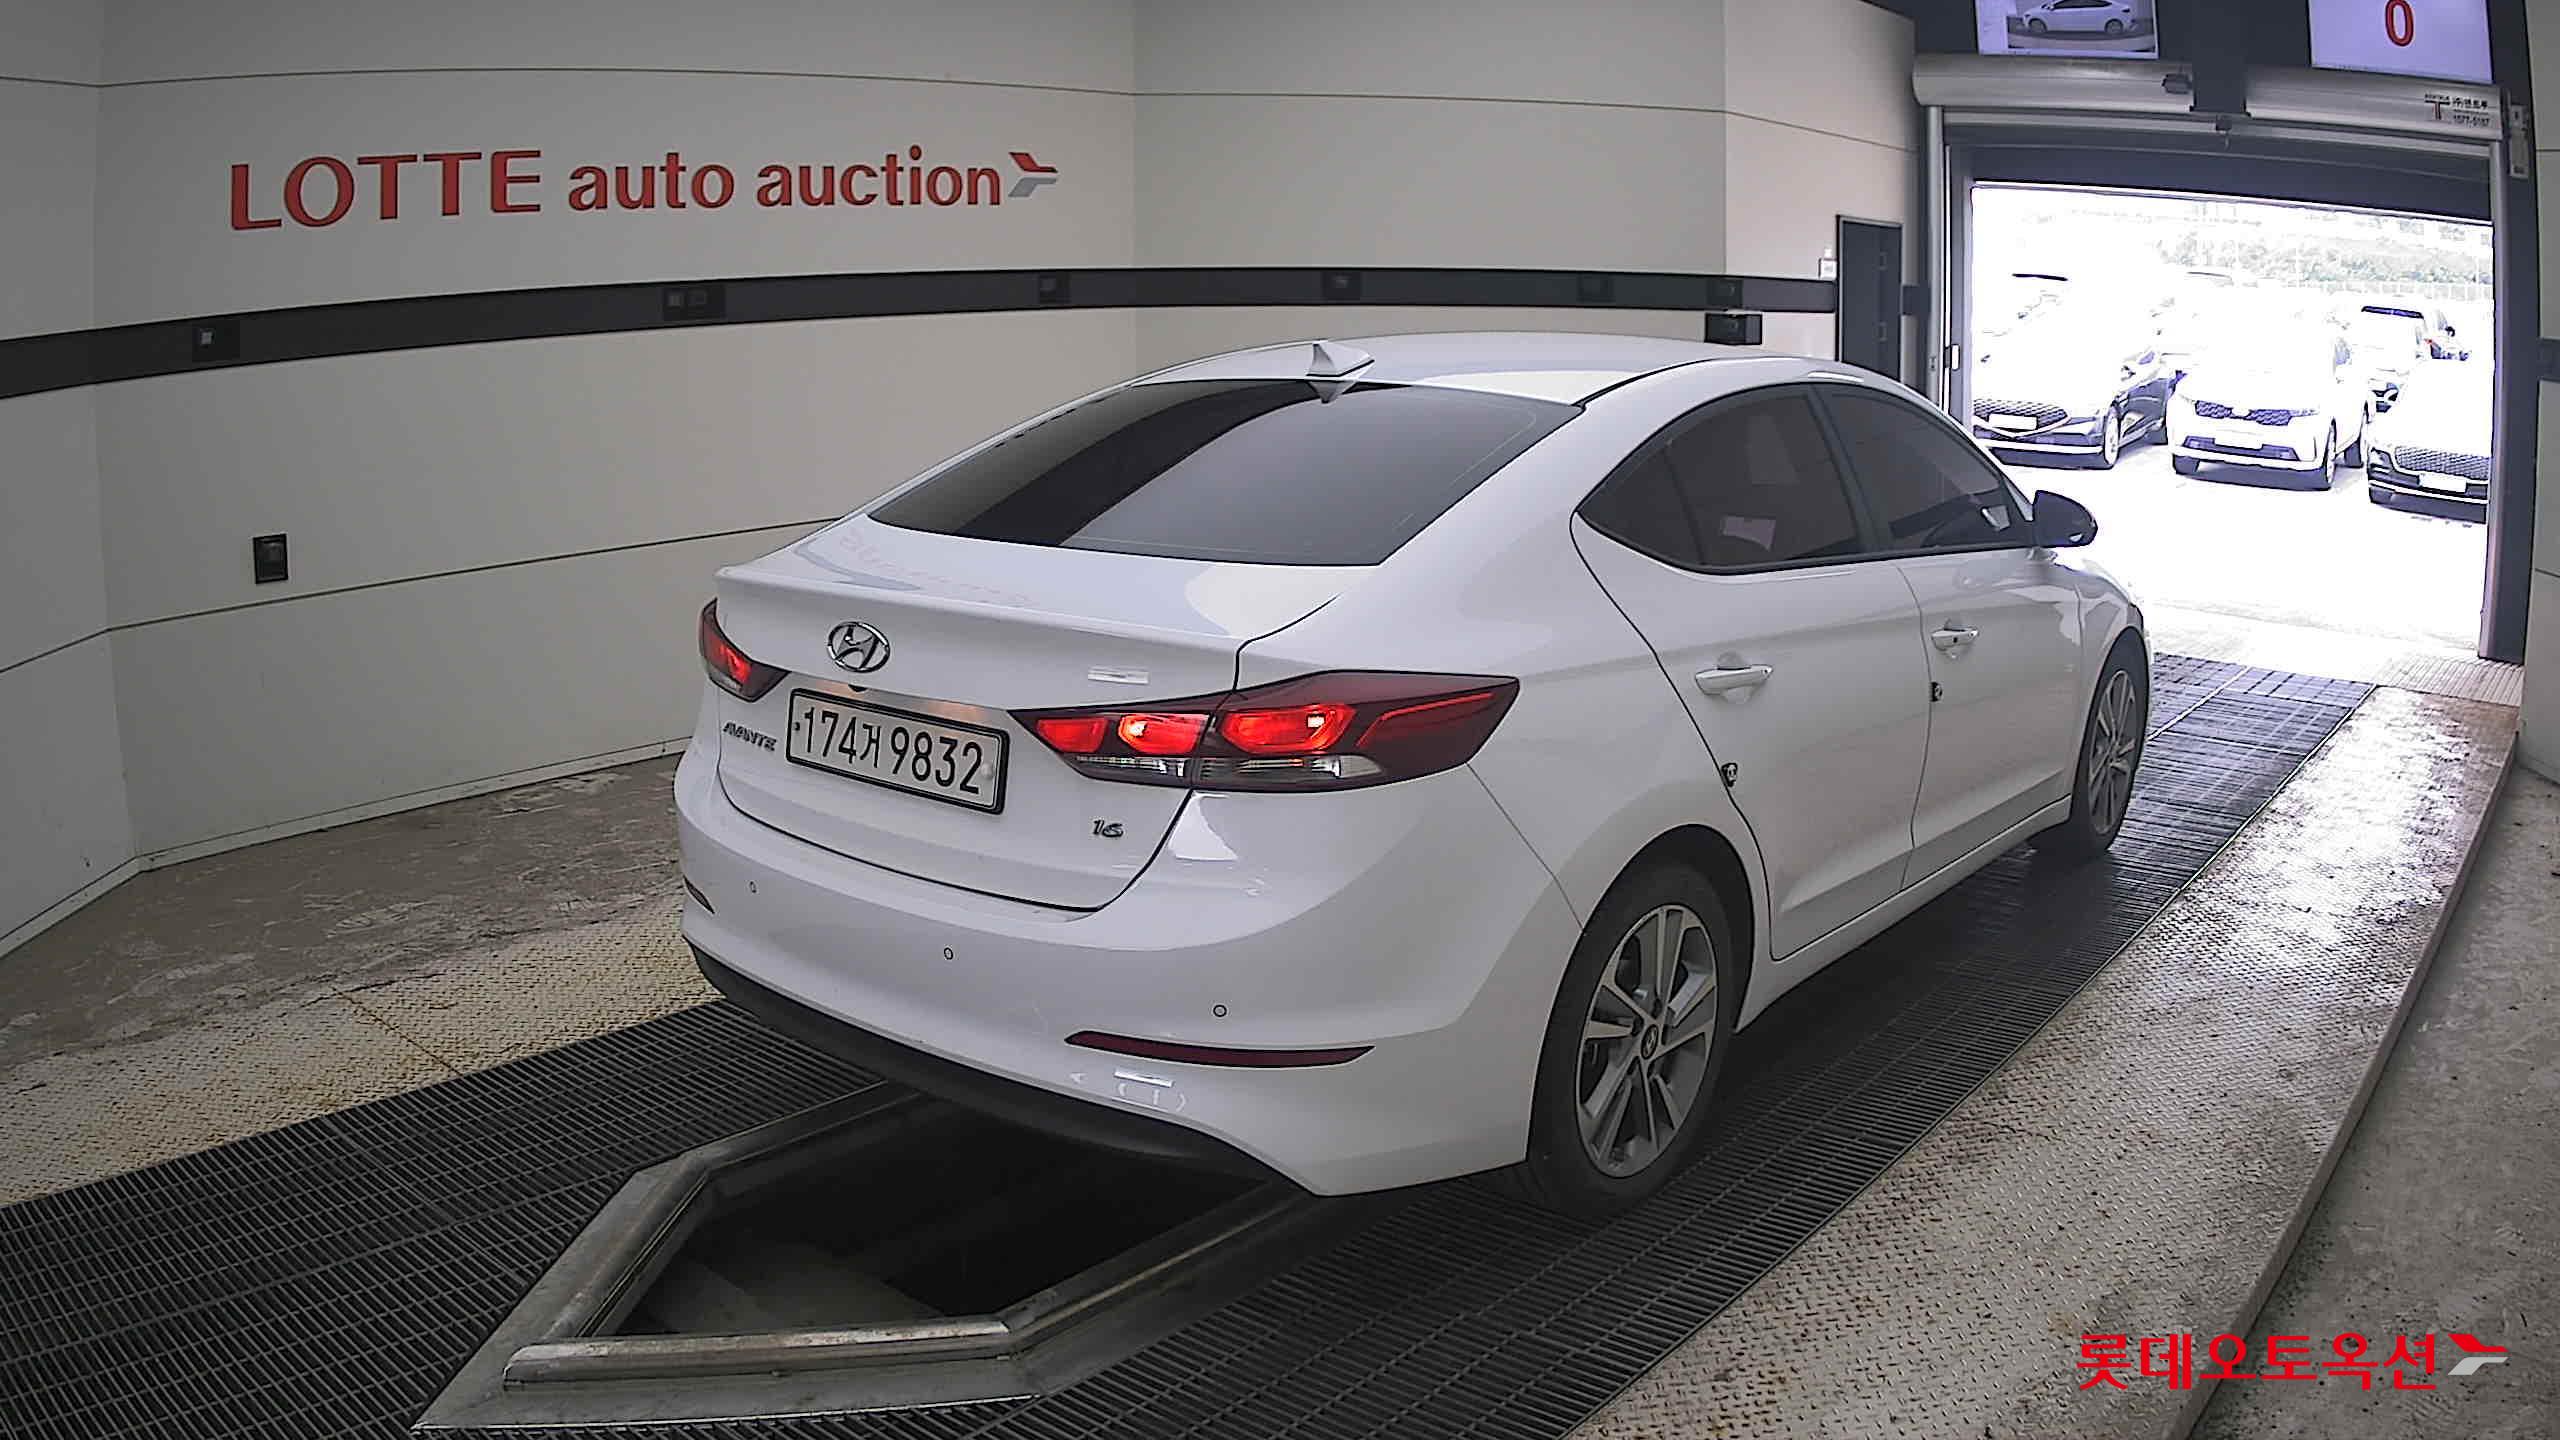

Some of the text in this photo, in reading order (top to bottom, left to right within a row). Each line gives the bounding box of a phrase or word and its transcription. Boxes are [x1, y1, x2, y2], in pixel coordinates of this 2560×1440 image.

[2385, 0, 2413, 46] 0
[231, 146, 1002, 230] LOTTE auto auction
[890, 726, 982, 795] 9832
